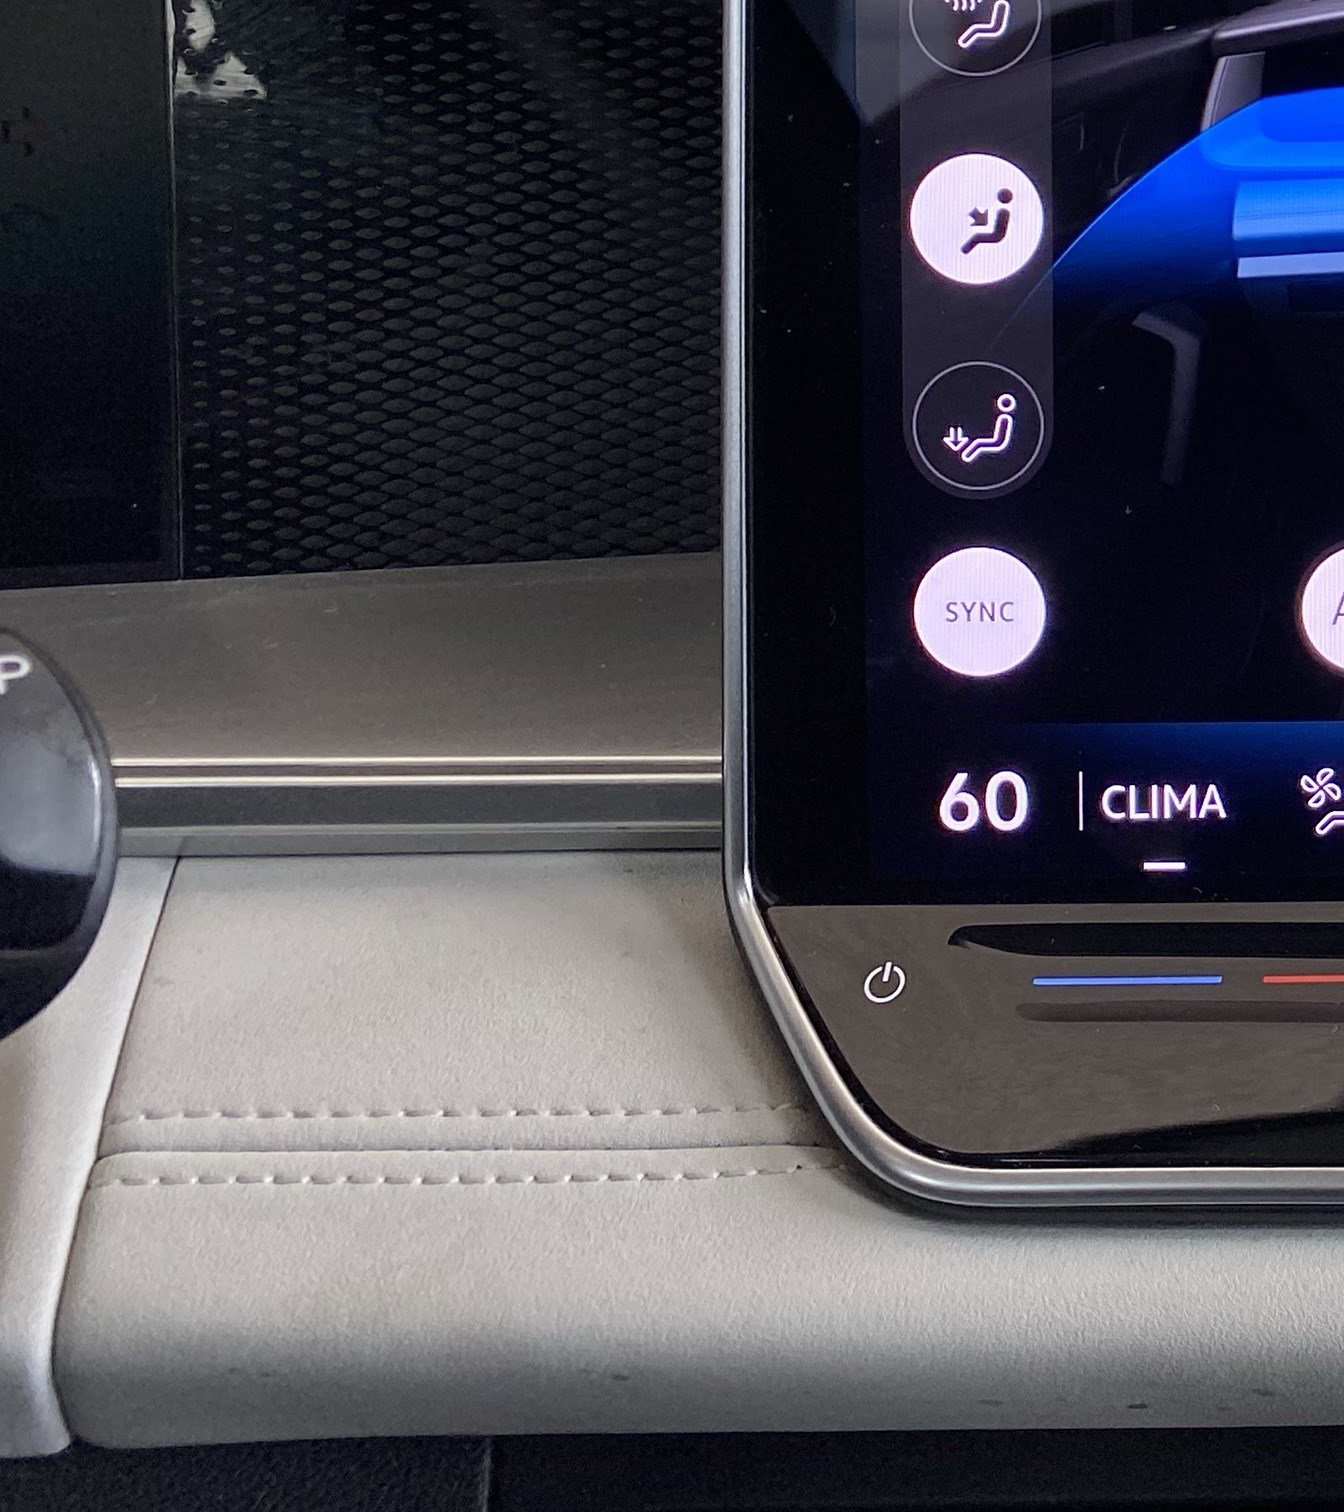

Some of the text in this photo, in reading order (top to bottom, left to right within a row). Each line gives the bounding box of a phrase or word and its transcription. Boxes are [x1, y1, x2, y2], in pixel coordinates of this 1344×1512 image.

[945, 601, 1015, 624] SYNC
[939, 770, 1031, 832] 60
[1101, 783, 1228, 821] CLIMA
